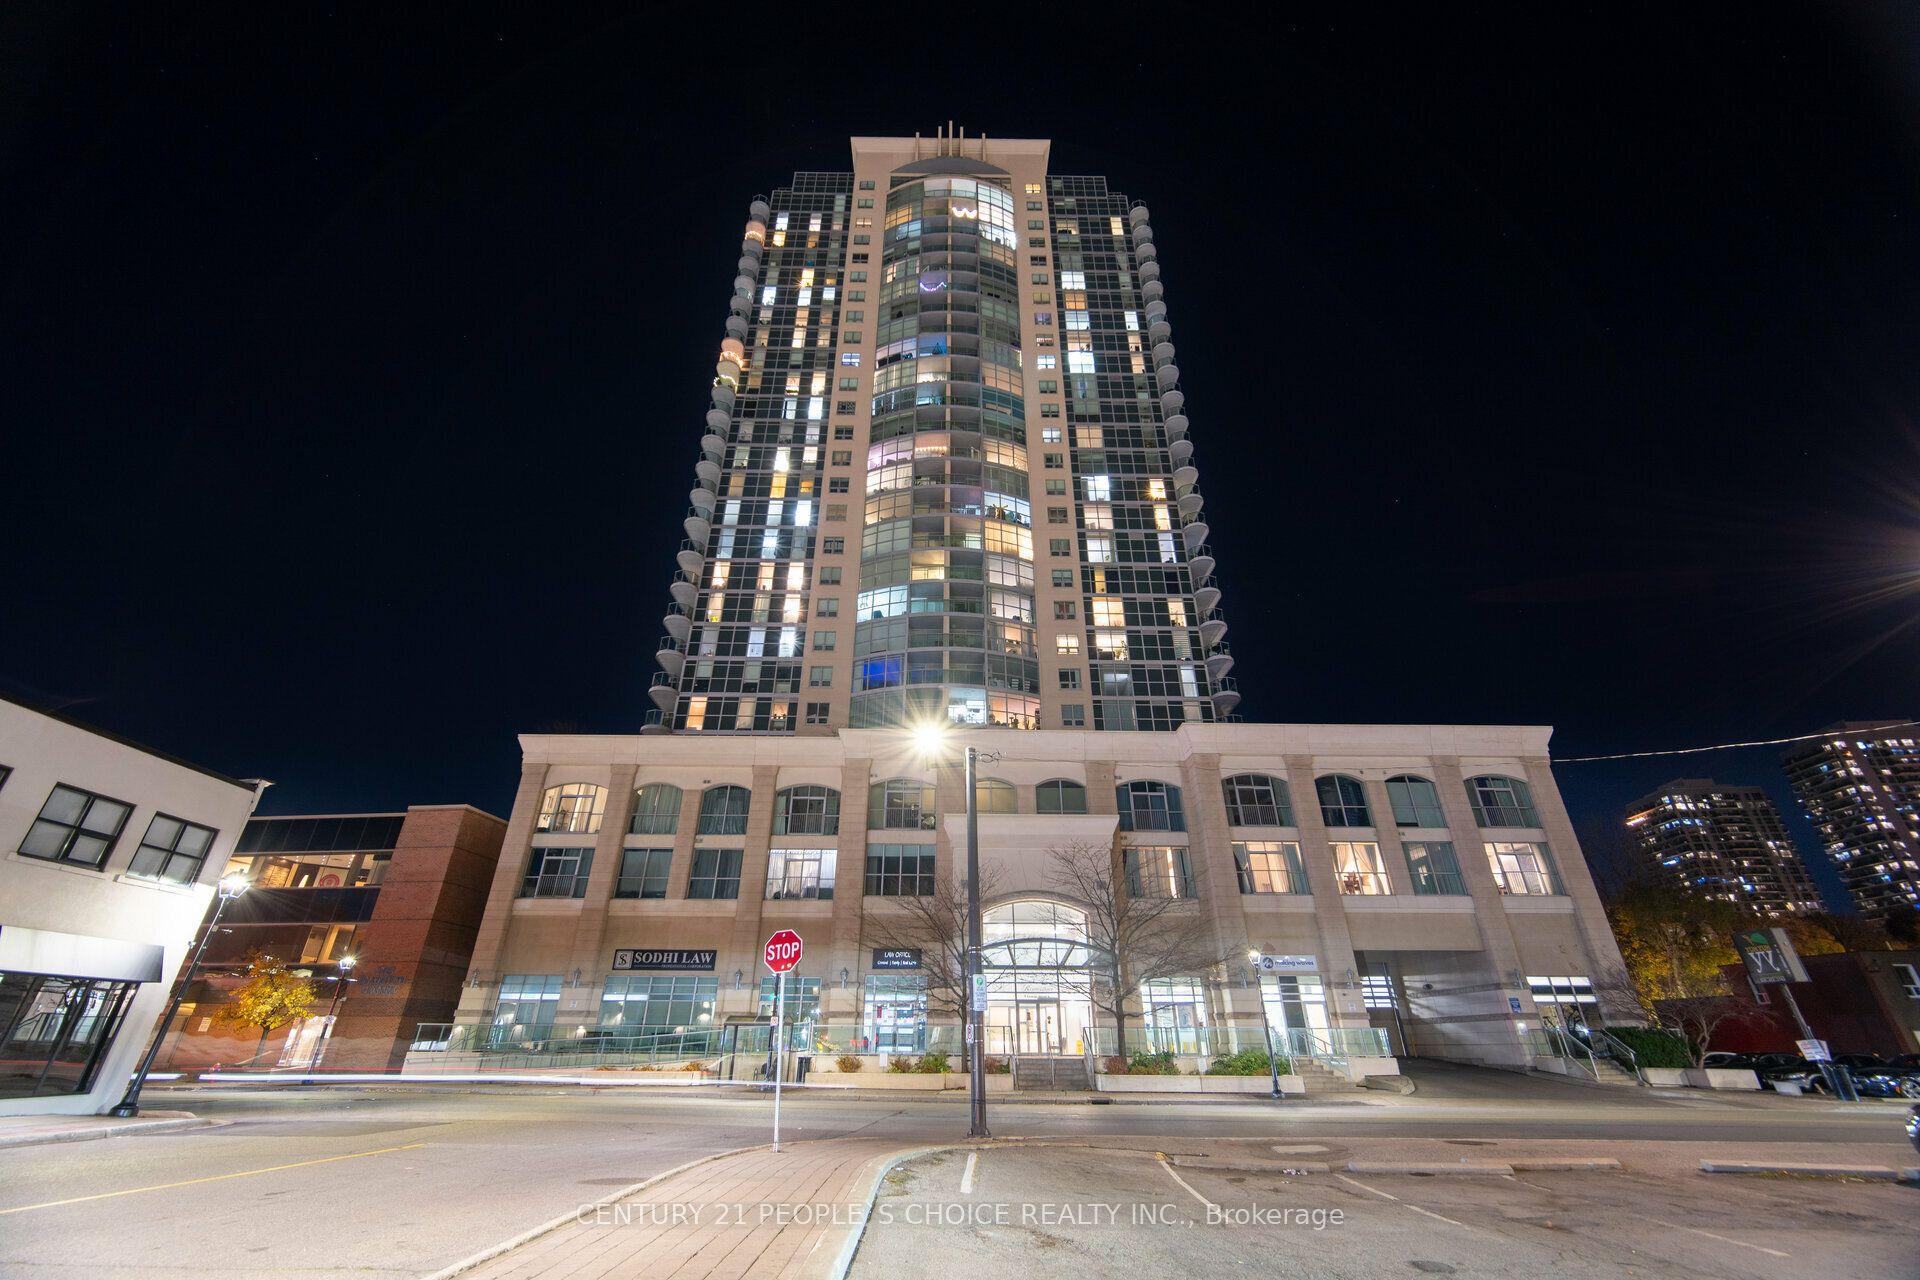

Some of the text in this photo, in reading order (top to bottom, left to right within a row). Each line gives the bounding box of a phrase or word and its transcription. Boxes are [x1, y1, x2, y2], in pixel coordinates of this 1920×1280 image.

[633, 952, 714, 964] SODHI LAW
[767, 941, 800, 961] STOP
